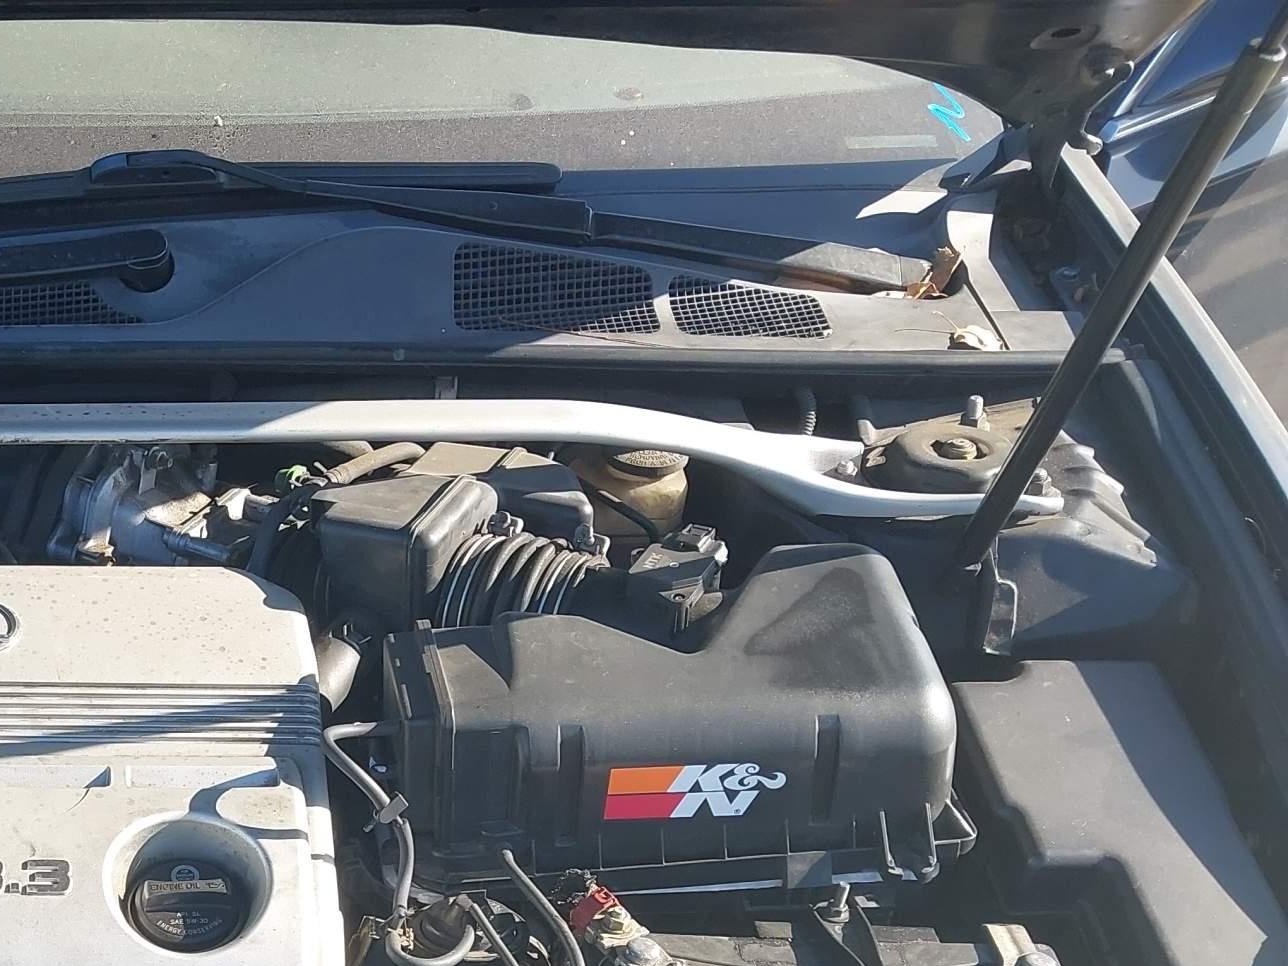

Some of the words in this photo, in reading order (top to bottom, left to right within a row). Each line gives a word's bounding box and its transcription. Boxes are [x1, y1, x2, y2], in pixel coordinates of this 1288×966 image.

[667, 762, 787, 818] K&N
[149, 881, 184, 891] ENGINE
[185, 881, 200, 890] OIL
[156, 920, 183, 936] ENERGY
